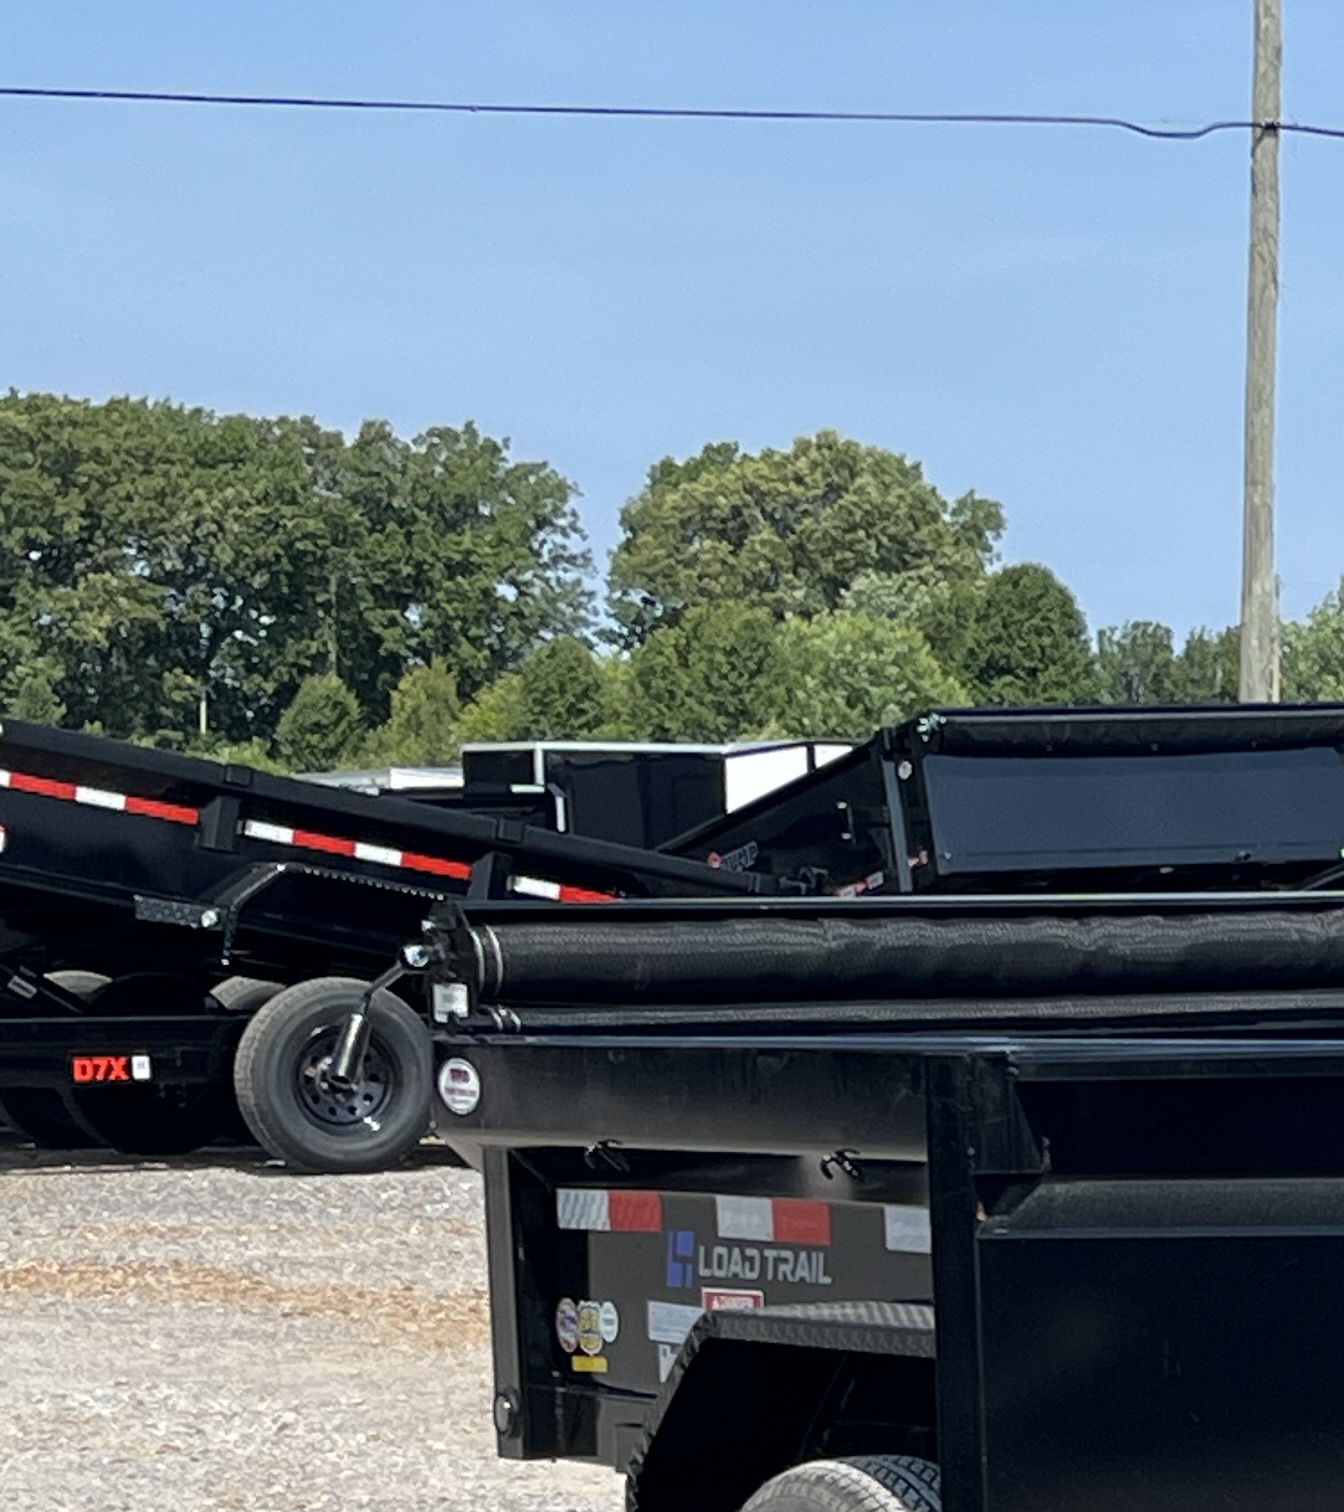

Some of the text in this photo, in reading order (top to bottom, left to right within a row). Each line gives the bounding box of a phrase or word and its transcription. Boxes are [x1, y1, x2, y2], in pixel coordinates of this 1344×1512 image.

[73, 1056, 129, 1083] D7X
[698, 1245, 833, 1285] LOAD TRAIL
